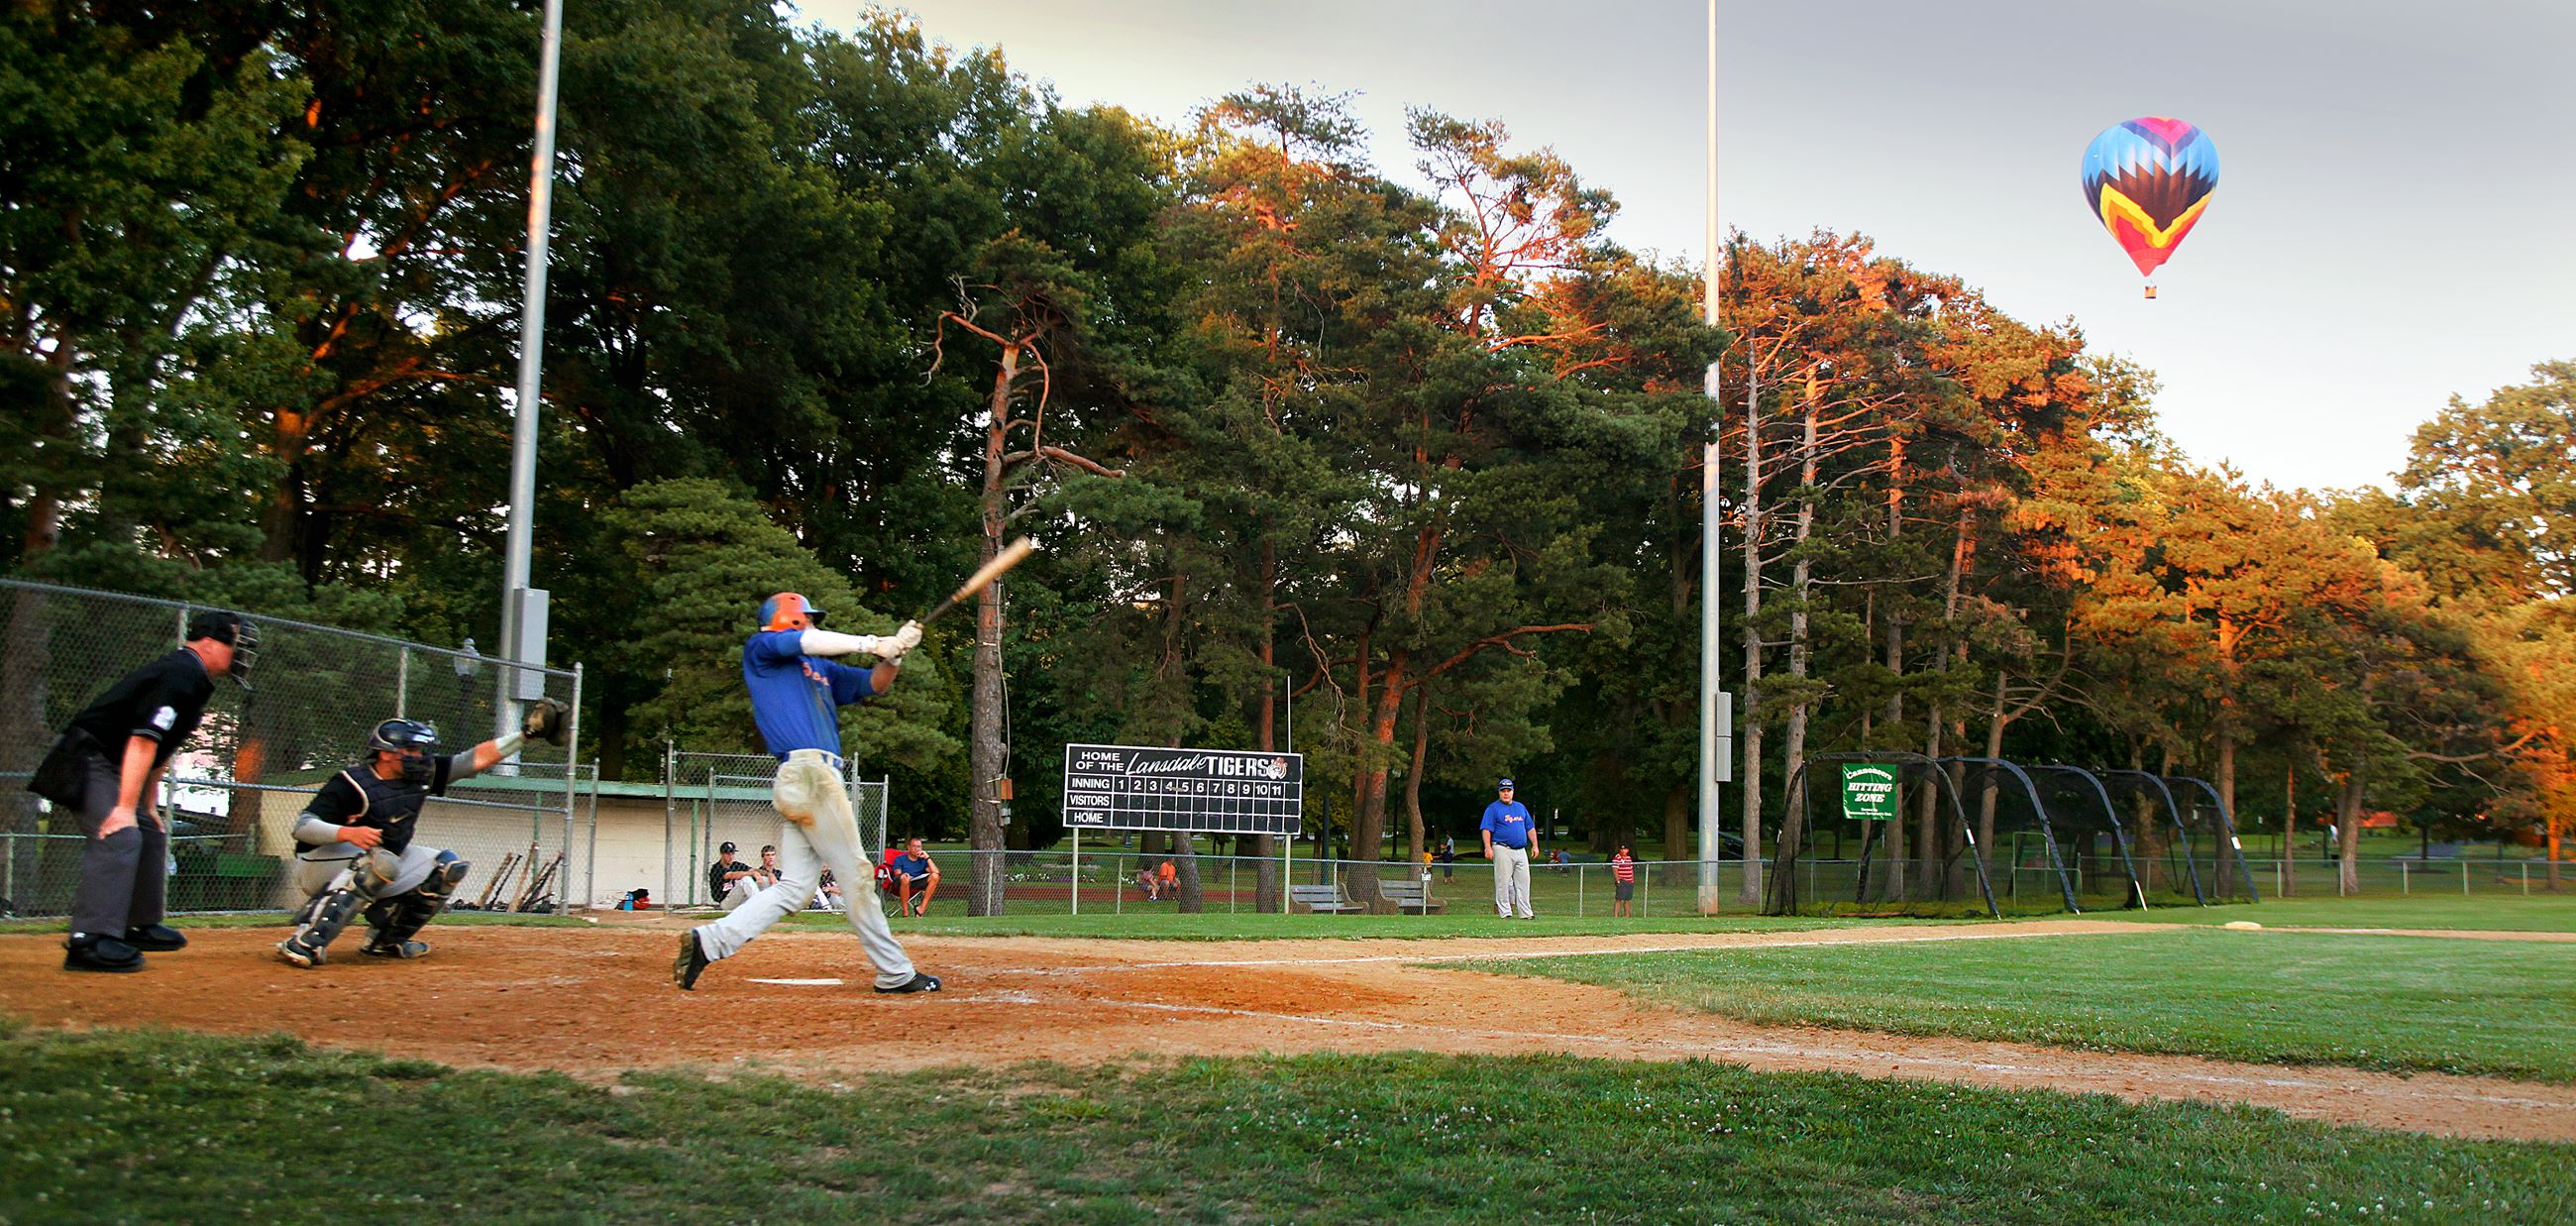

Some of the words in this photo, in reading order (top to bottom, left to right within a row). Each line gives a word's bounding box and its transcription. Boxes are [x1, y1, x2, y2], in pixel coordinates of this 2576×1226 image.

[1081, 751, 1121, 761] HOME
[1075, 761, 1094, 770] OF
[1099, 762, 1125, 772] THE
[1126, 752, 1208, 776] Lansdale
[1207, 756, 1269, 777] TIGERS
[1072, 778, 1110, 789] INNING
[1118, 780, 1125, 790] 1
[1133, 780, 1141, 790] 2
[1149, 781, 1157, 791] 3
[1165, 781, 1173, 791] 4
[1181, 782, 1189, 792] 5
[1196, 782, 1205, 793] 6
[1212, 783, 1221, 793] 7
[1227, 783, 1235, 794] 8
[1242, 784, 1250, 794] 9
[1255, 785, 1268, 795] 10
[1271, 785, 1281, 795] 11
[1848, 782, 1892, 792] HITTING
[1070, 795, 1110, 806] VISITORS
[1855, 793, 1885, 803] ZONE
[1074, 812, 1104, 823] HOME
